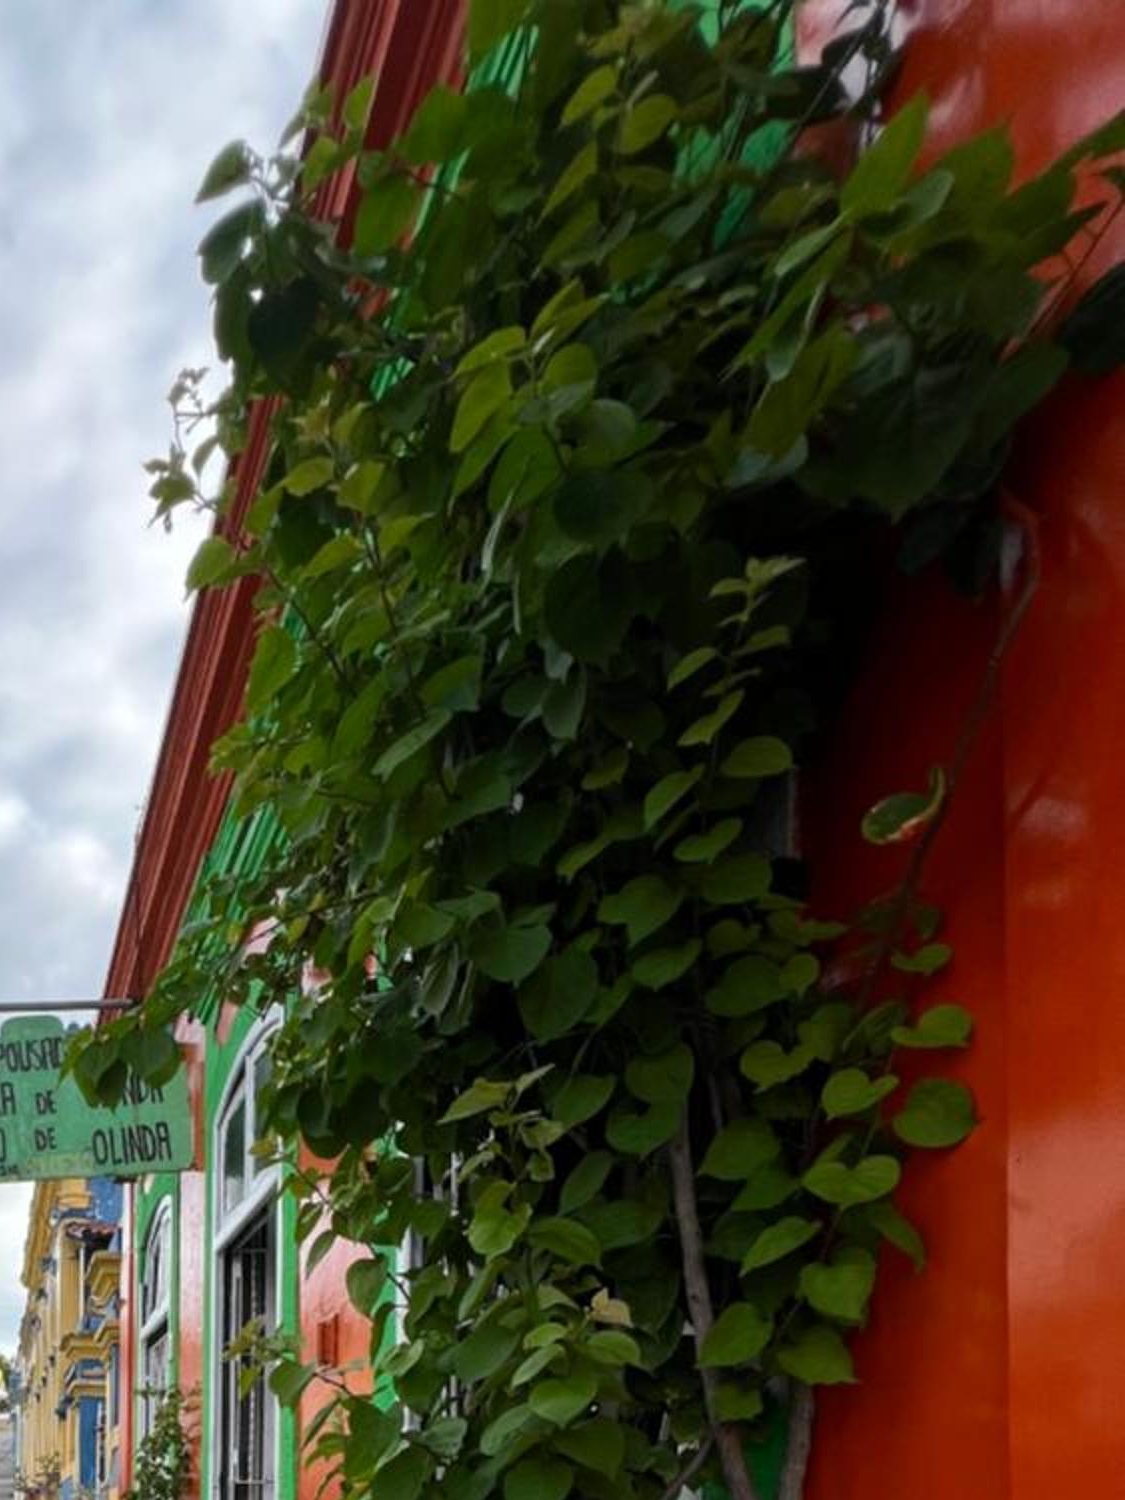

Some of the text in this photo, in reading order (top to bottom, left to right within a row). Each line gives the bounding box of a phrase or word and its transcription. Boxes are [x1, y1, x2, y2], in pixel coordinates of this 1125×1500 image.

[35, 1090, 57, 1115] DE
[34, 1127, 57, 1152] DE
[92, 1121, 172, 1166] OLINDA
